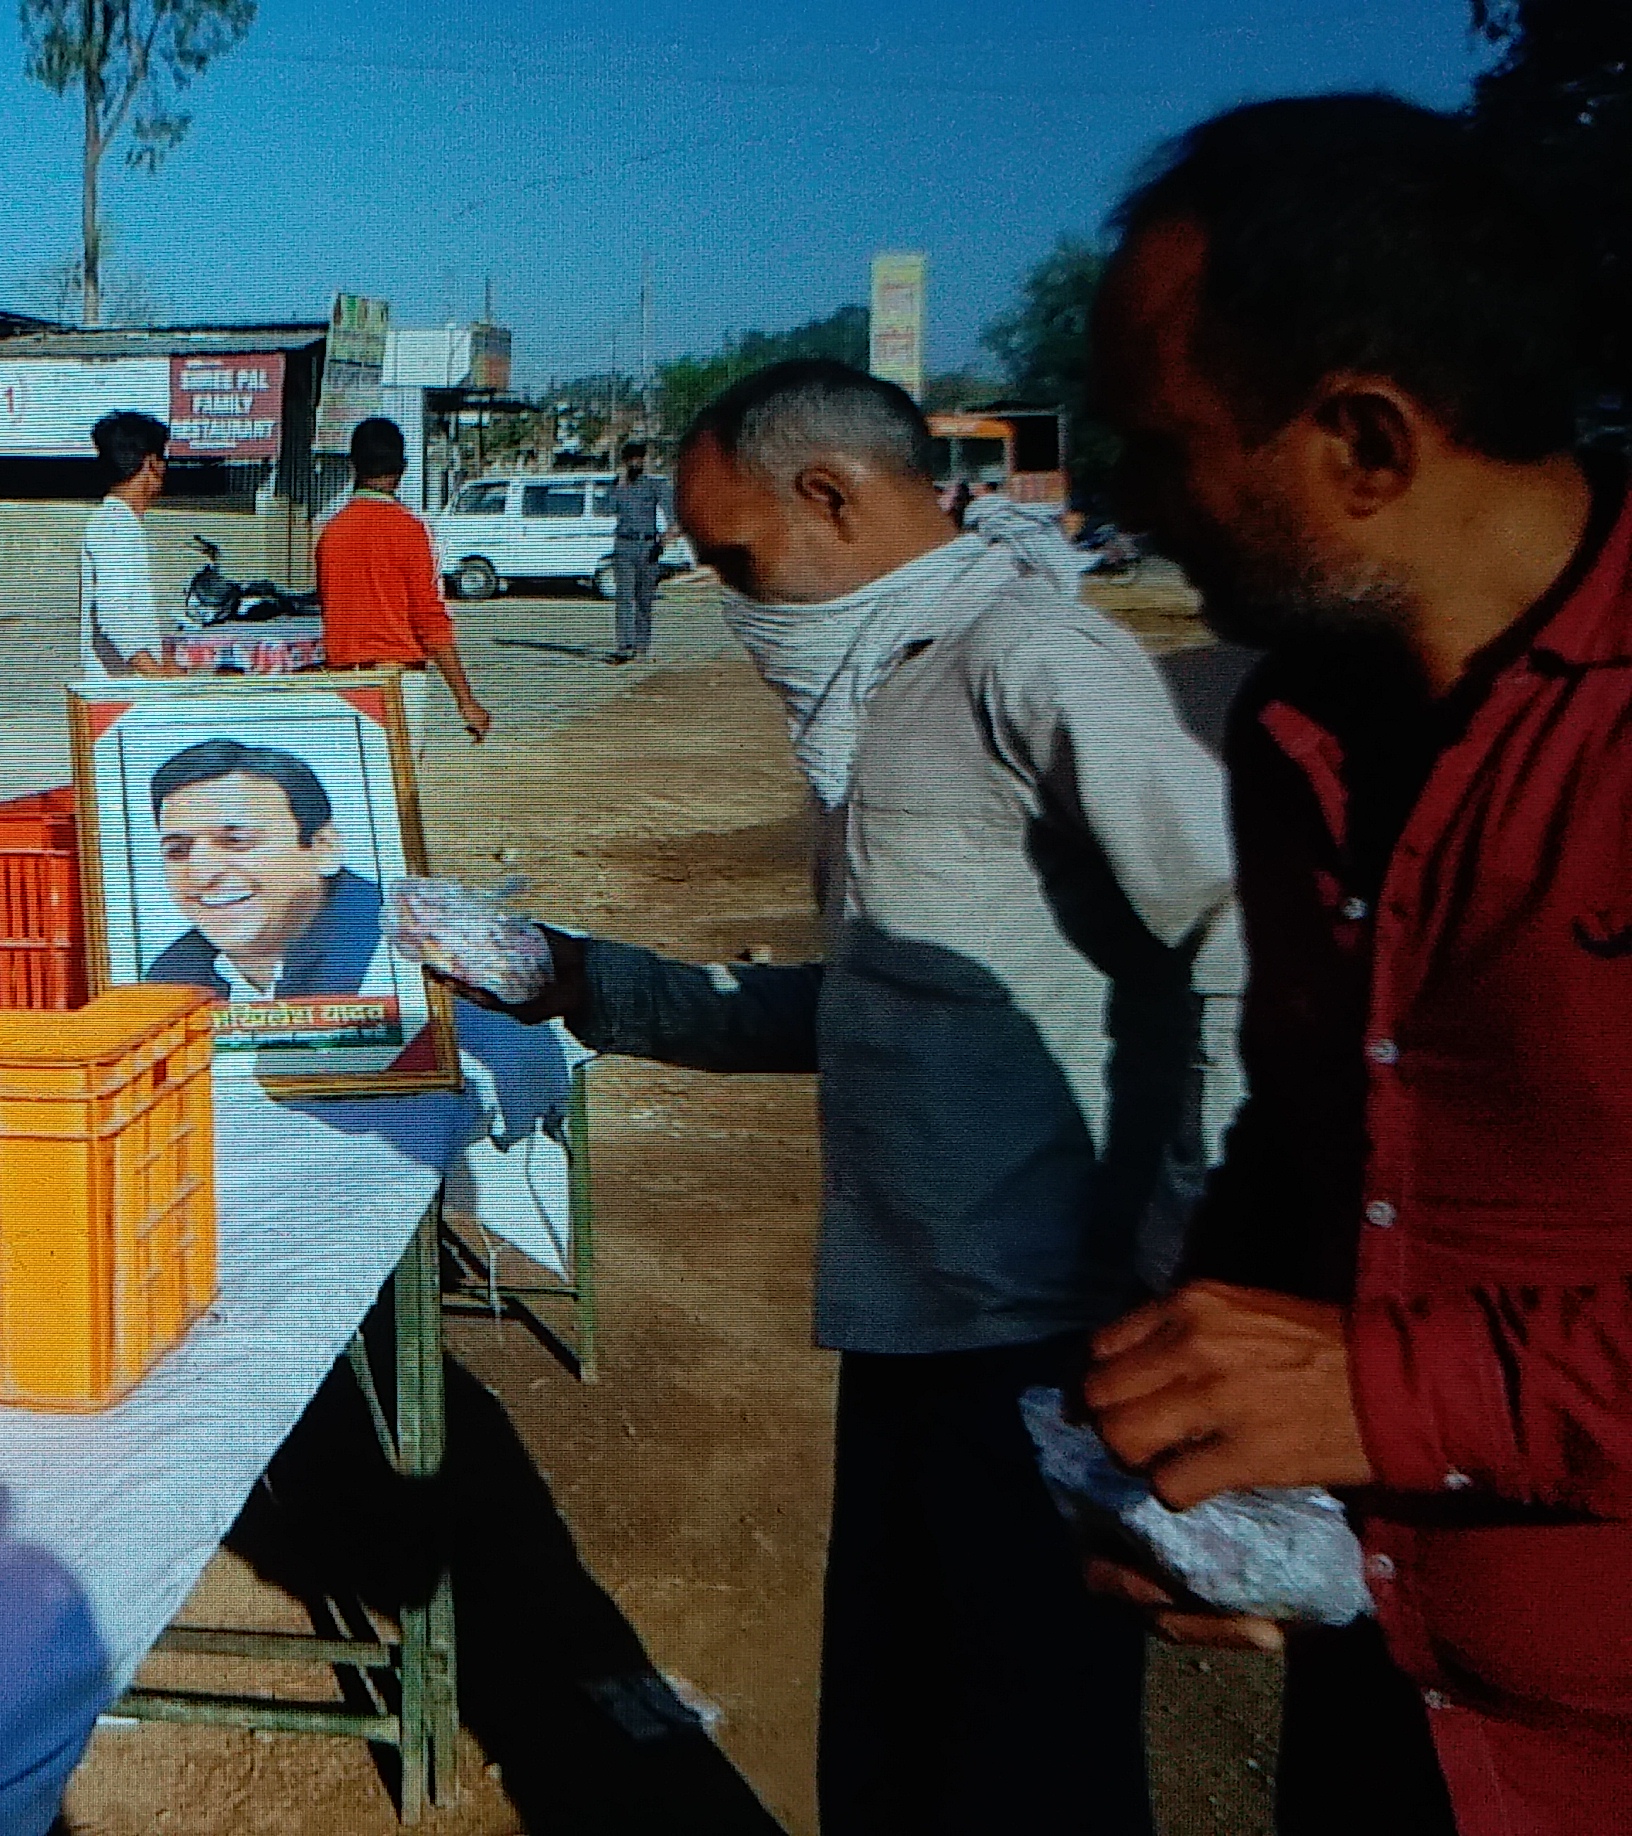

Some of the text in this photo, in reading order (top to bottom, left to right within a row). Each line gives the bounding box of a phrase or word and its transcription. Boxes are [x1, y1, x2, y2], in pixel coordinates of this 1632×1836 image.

[236, 368, 270, 391] PAL
[4, 386, 15, 414] 1
[192, 394, 254, 415] FAMILY
[171, 418, 276, 440] RESTAURANT
